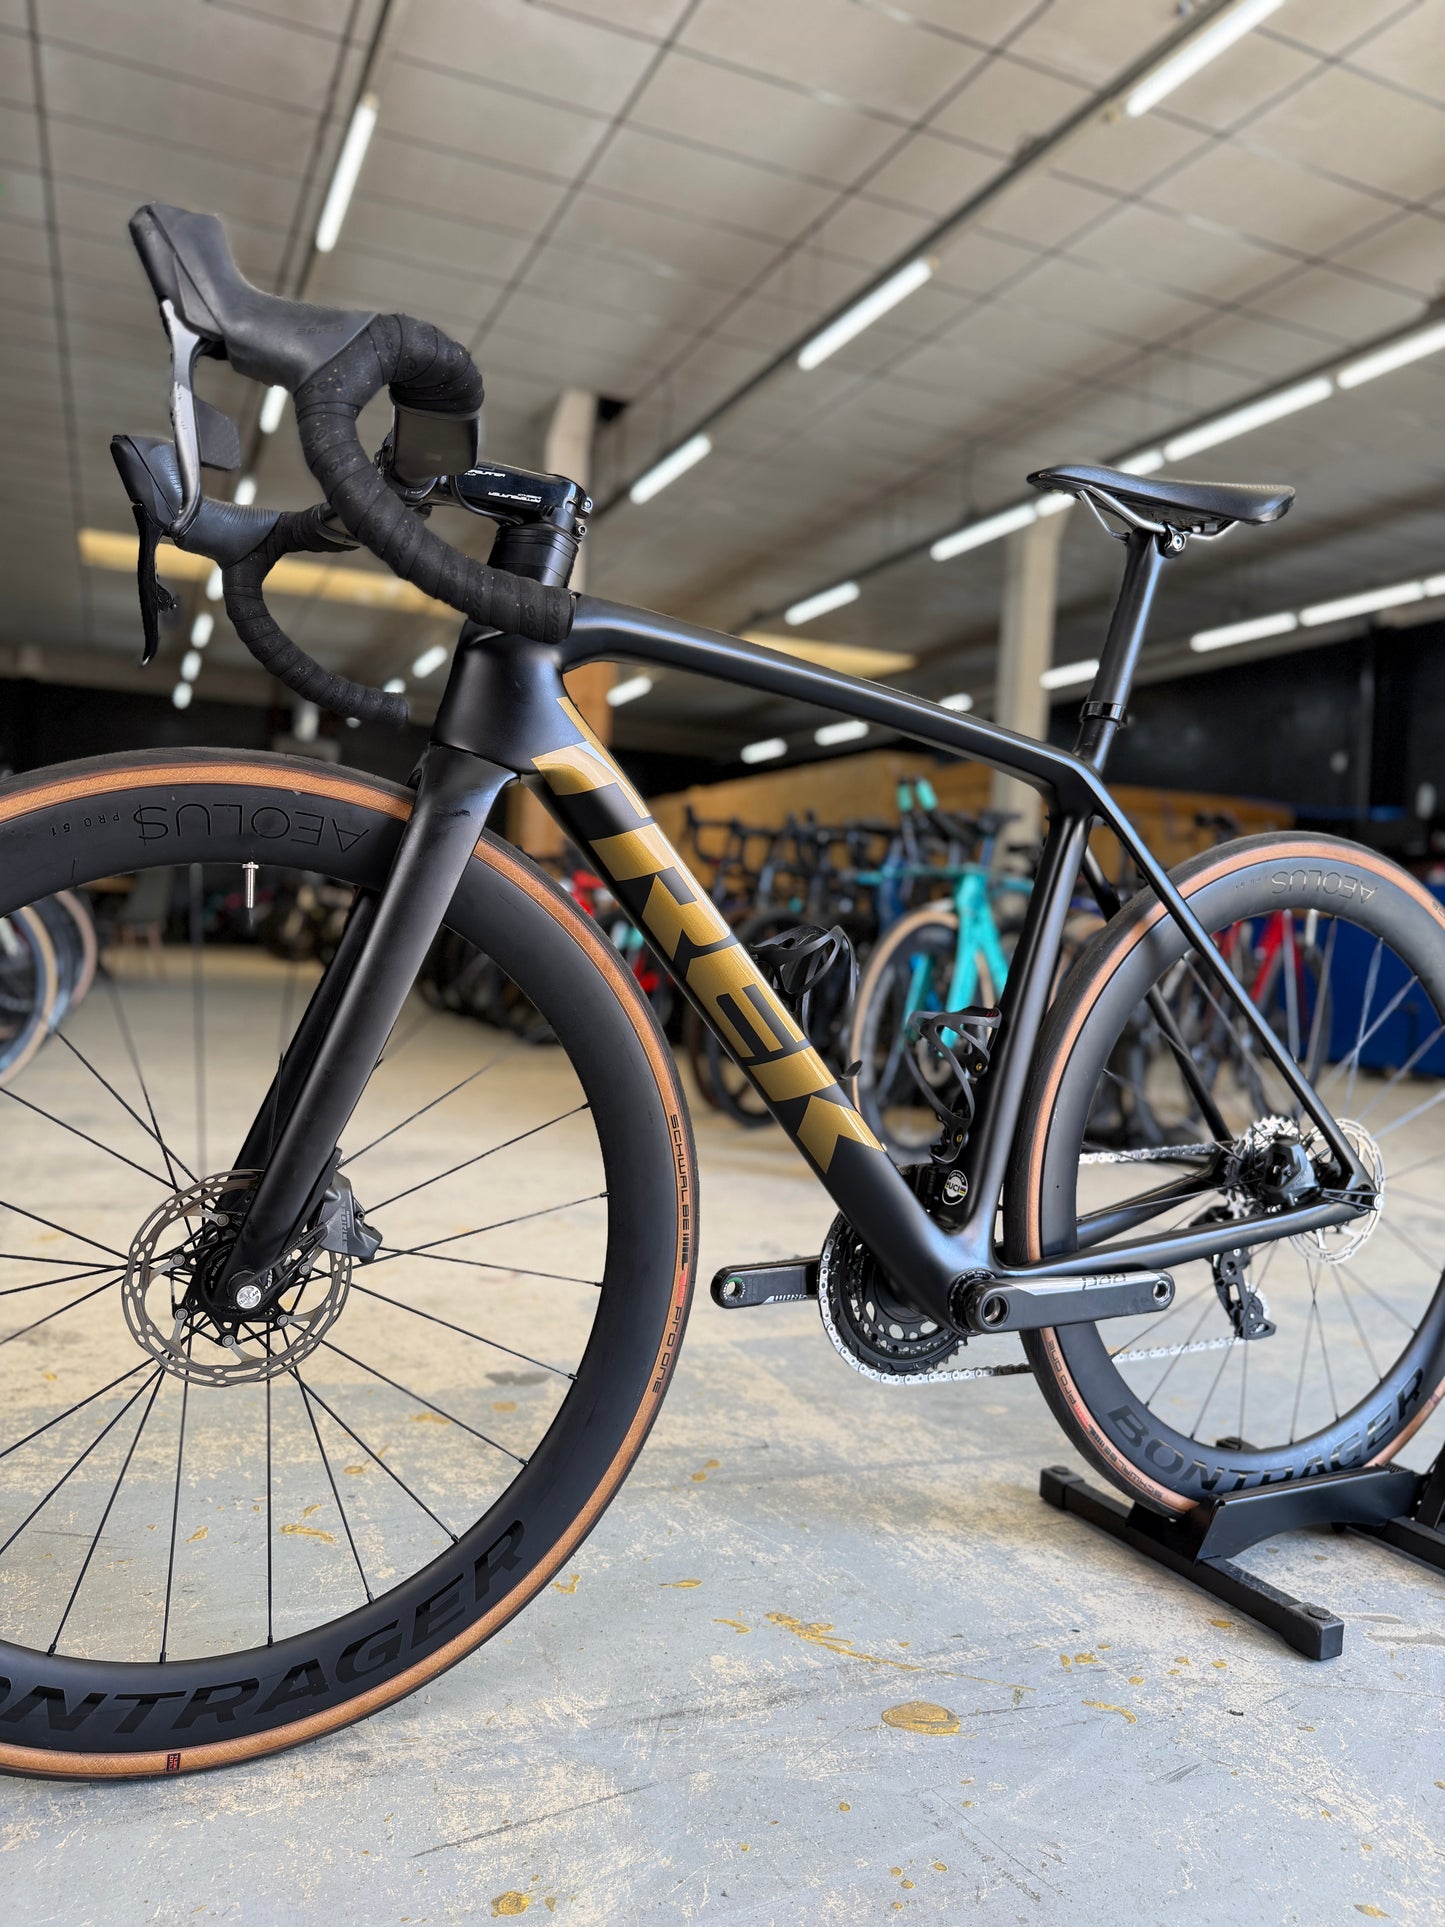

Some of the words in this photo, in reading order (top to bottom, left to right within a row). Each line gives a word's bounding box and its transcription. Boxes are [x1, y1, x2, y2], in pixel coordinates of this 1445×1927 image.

[51, 822, 71, 837] 51
[83, 812, 121, 828] PRO
[133, 803, 371, 853] AEOLUS
[1271, 869, 1378, 903] AEOLUS
[531, 697, 886, 1174] TREK
[670, 1113, 690, 1232] SCHWALBE
[948, 1183, 960, 1192] UCI
[0, 1519, 525, 1734] NTRAGER
